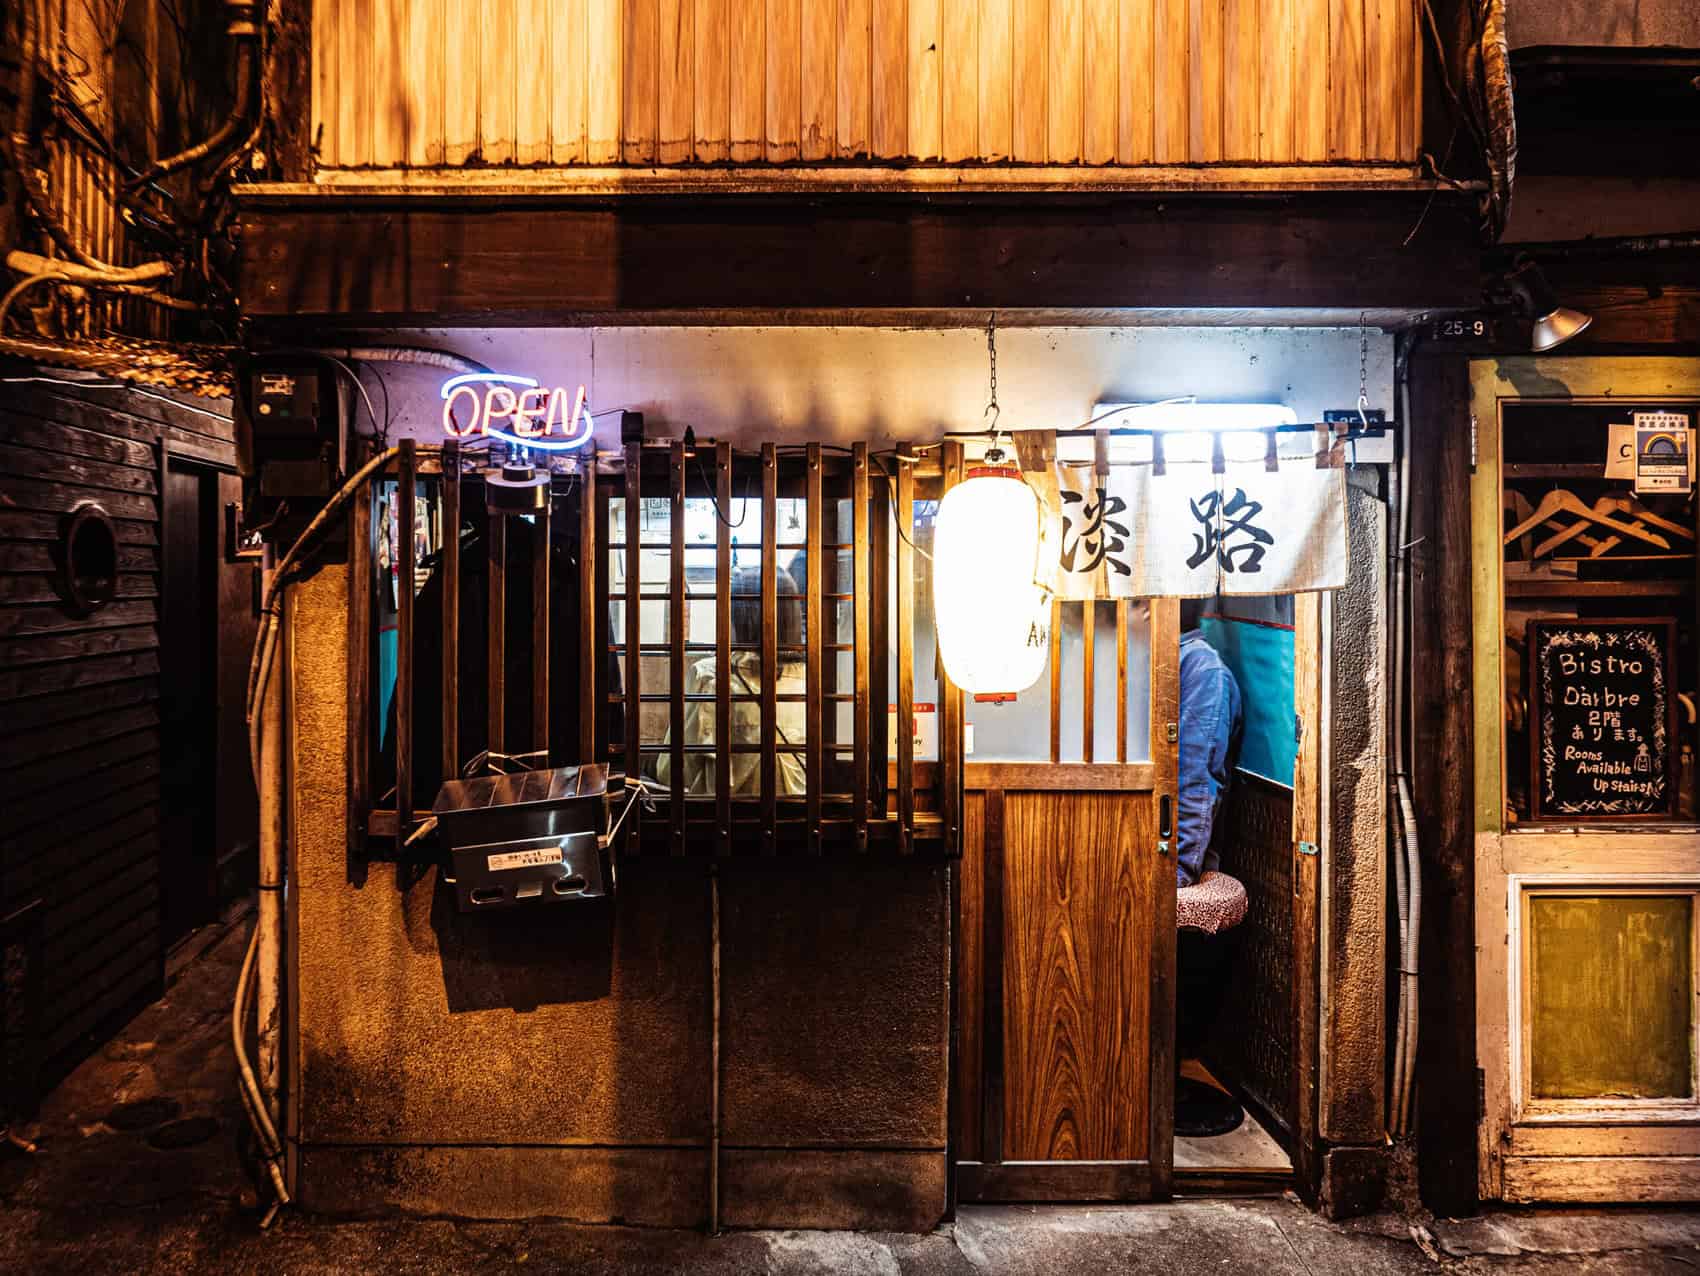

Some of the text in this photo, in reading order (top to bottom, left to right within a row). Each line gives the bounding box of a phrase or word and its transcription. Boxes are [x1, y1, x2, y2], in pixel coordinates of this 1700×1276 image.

[1443, 320, 1484, 336] 25-9
[442, 383, 588, 438] OPEN
[1059, 486, 1275, 577] 淡路
[1559, 651, 1643, 675] Bistro
[1565, 745, 1603, 761] Rooms
[1576, 761, 1632, 775] Available
[1593, 778, 1609, 793] Up
